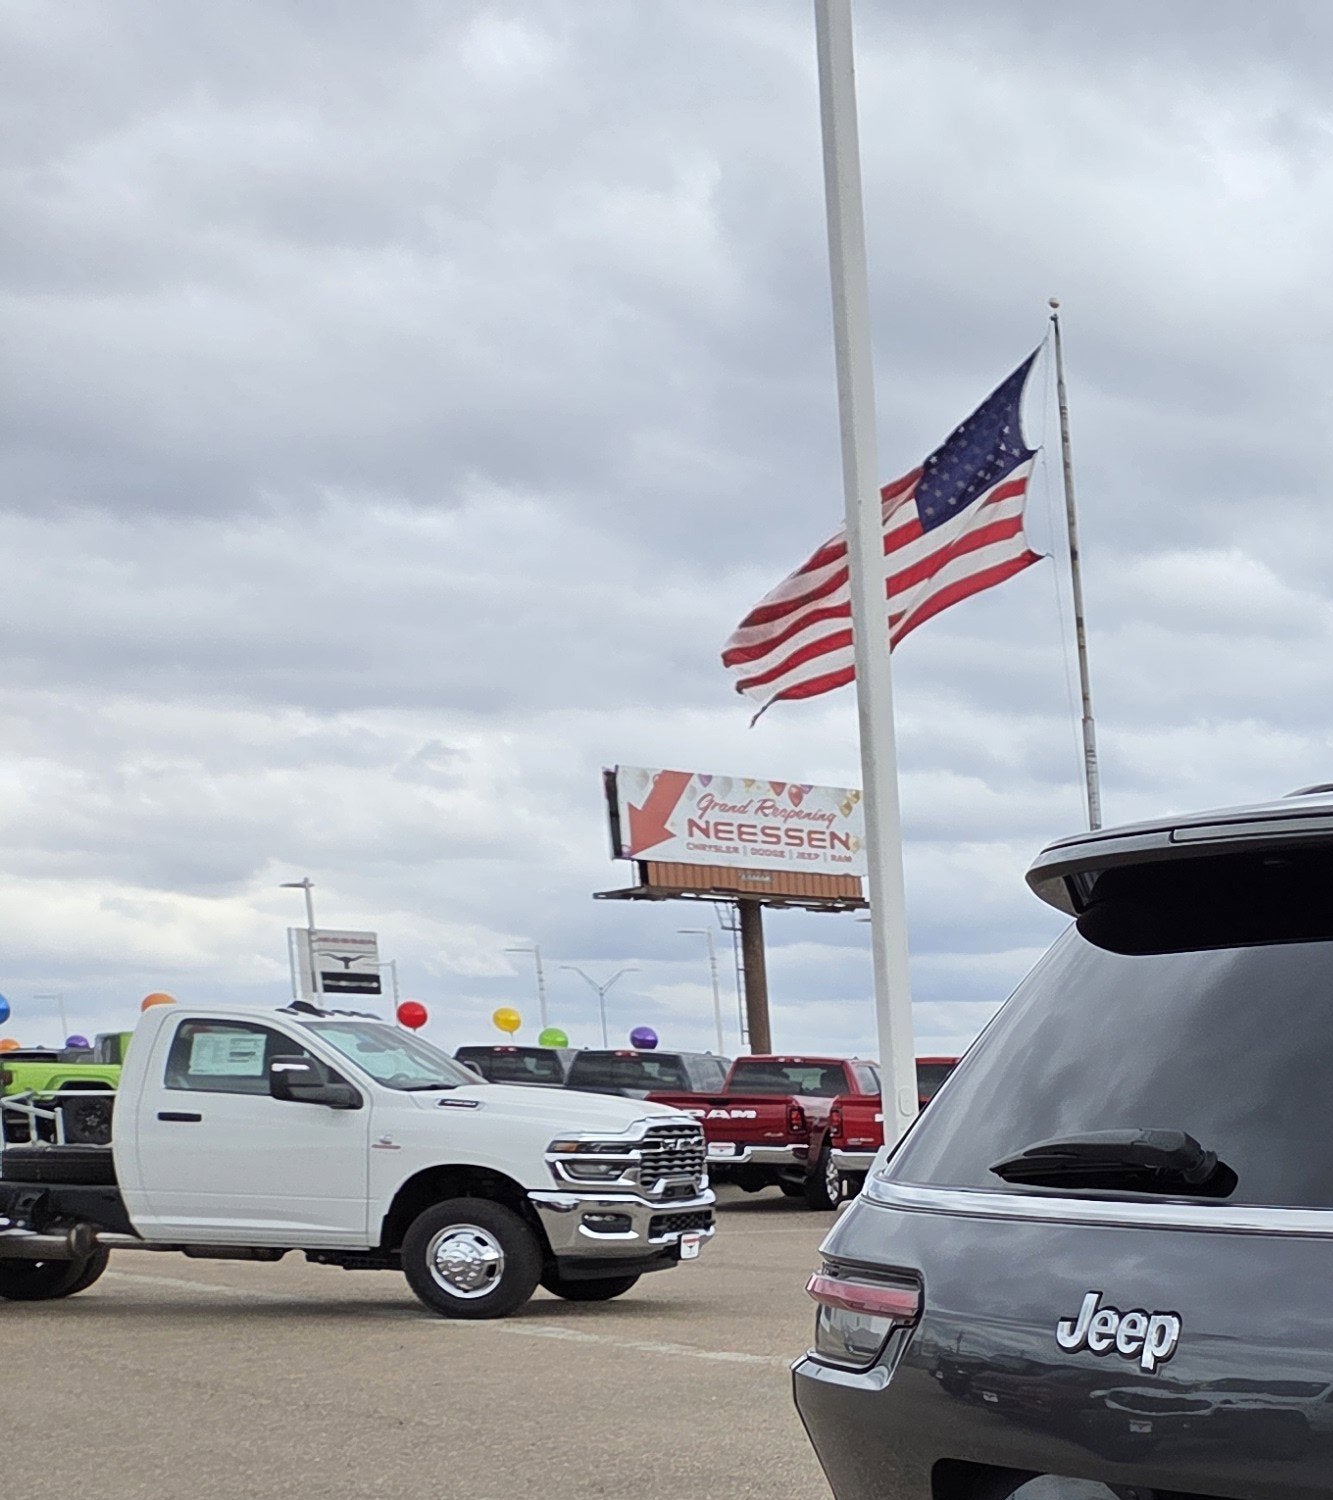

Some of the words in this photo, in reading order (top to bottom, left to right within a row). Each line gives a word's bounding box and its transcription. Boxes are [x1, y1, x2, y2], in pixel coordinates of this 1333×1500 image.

[697, 793, 749, 819] Grand
[754, 798, 836, 828] Reopening
[687, 818, 852, 851] NEESSEN
[682, 1109, 757, 1119] RAM
[1056, 1291, 1182, 1374] Jeep
